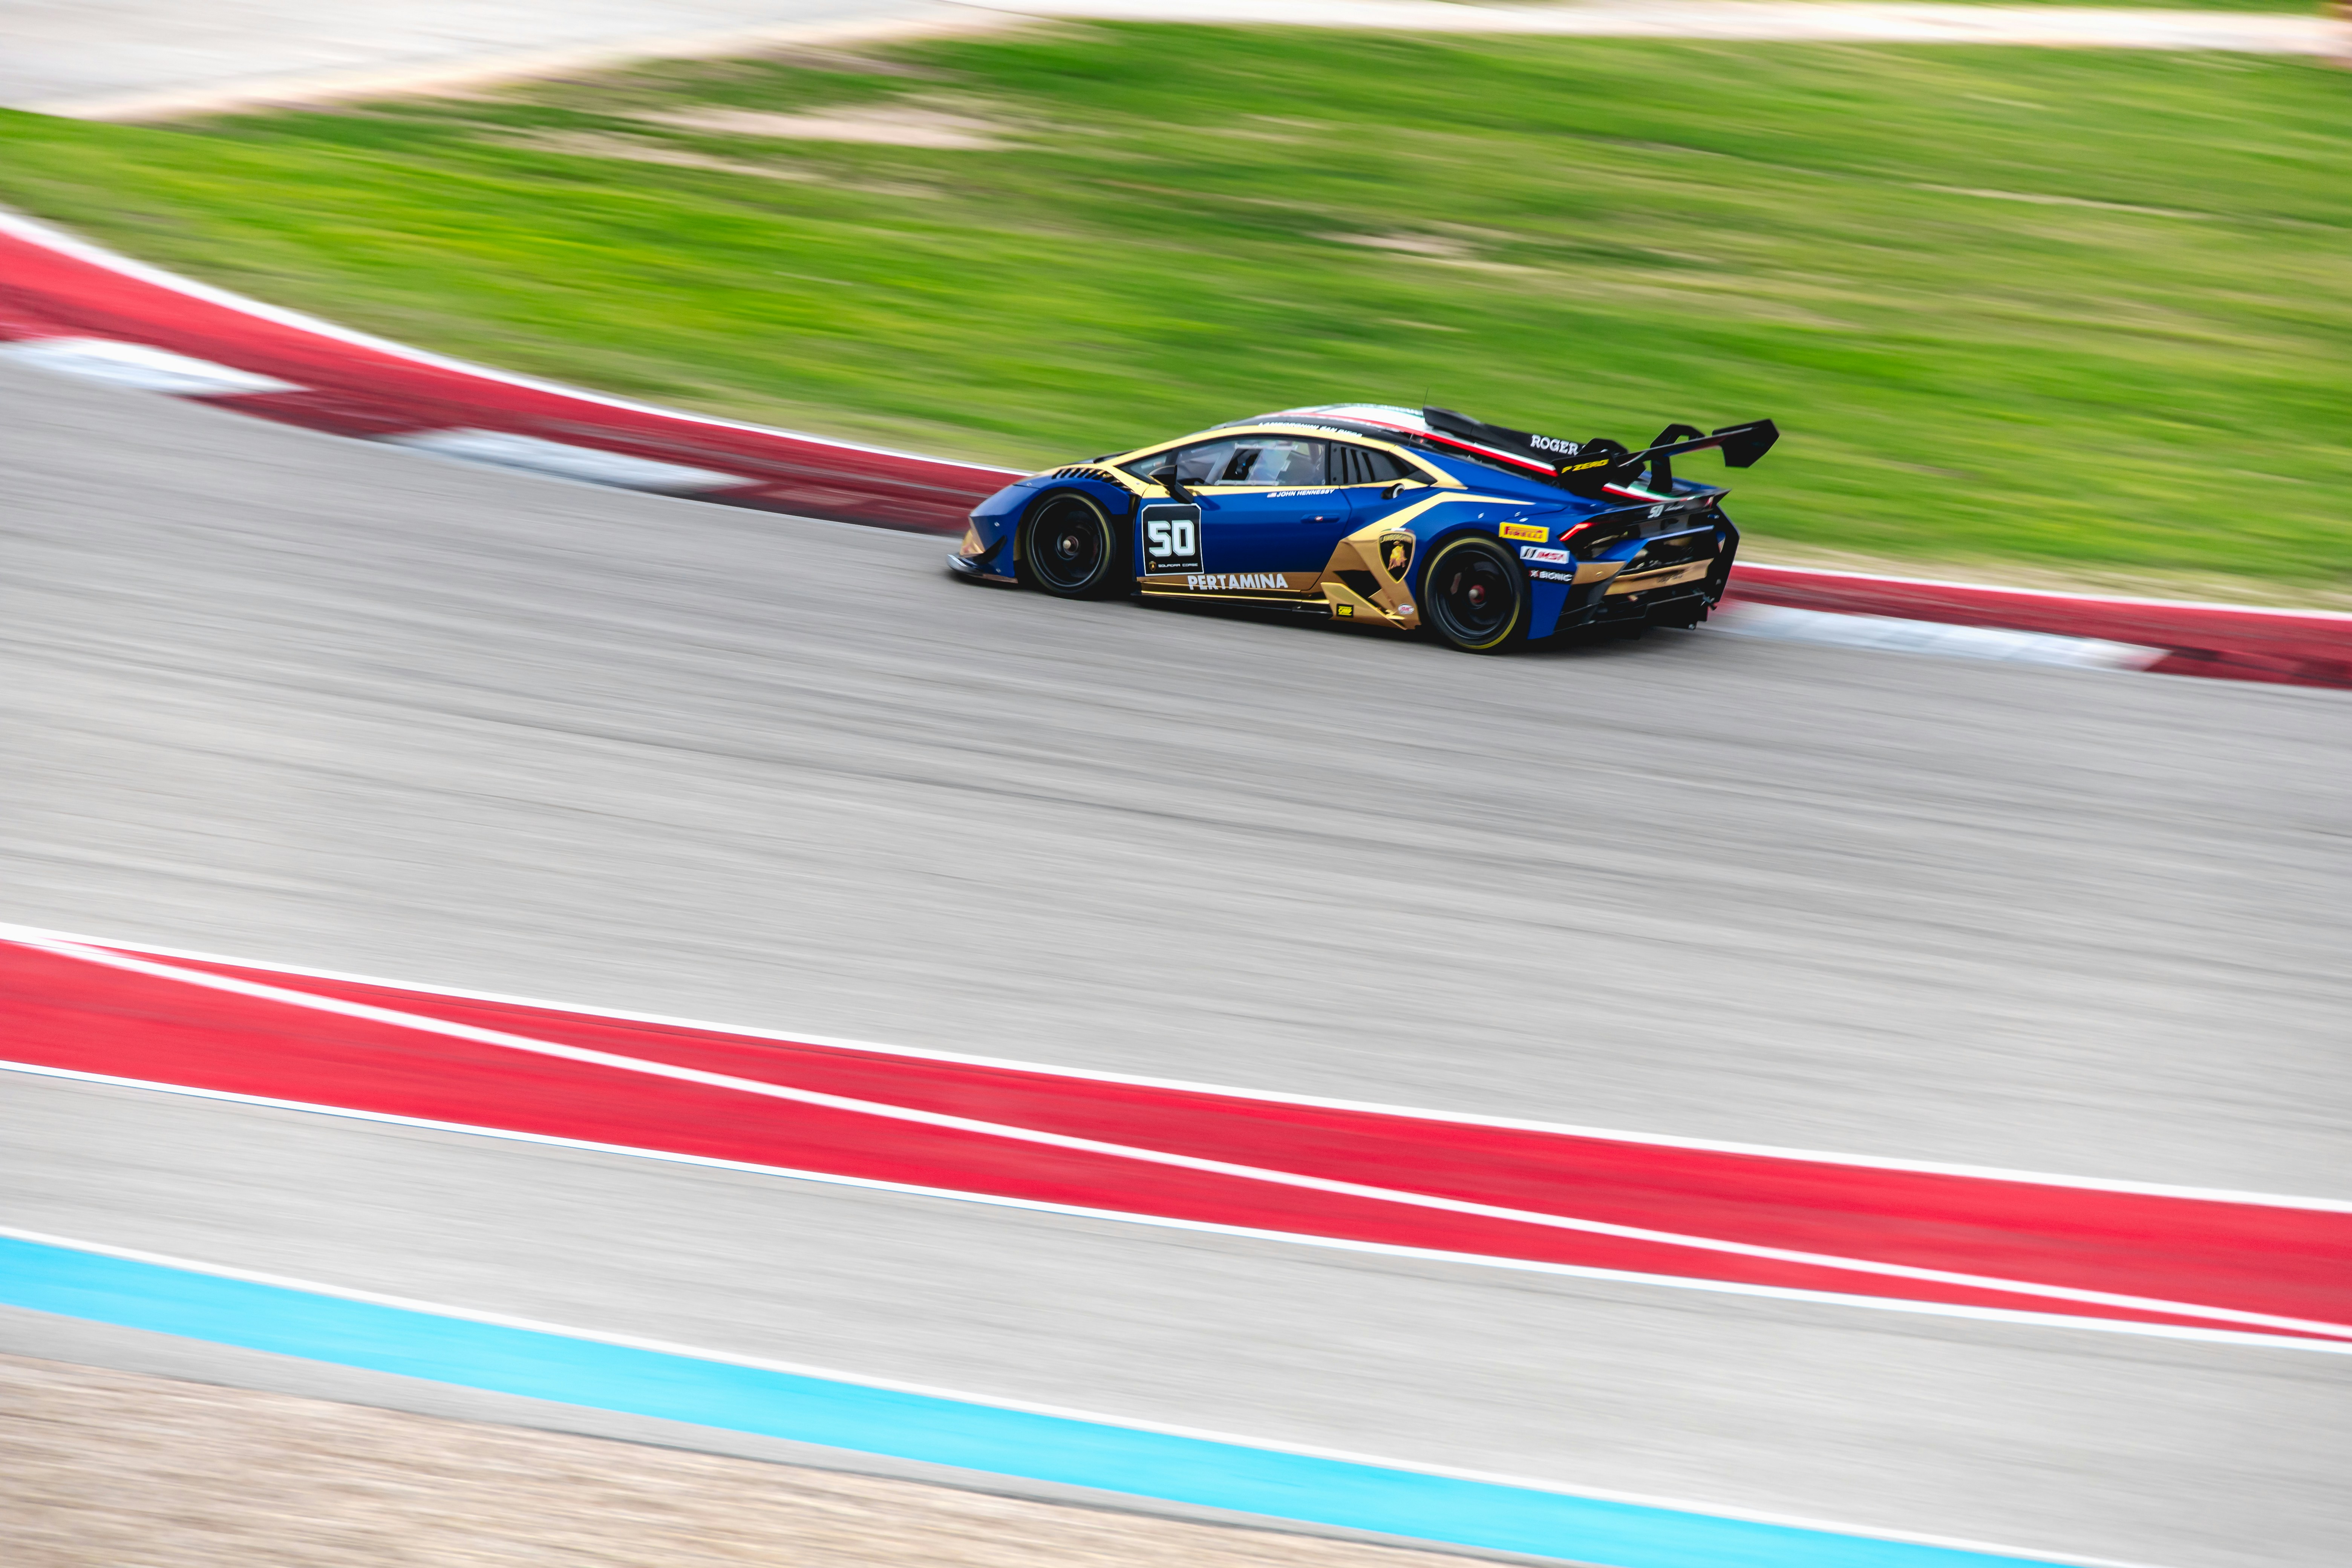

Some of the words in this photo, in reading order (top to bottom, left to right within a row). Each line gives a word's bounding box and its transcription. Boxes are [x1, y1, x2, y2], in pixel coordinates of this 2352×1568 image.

[1530, 434, 1578, 456] ROGER
[1572, 459, 1609, 471] ZERO
[1148, 520, 1195, 557] 50
[1187, 573, 1288, 590] PERTAMINA
